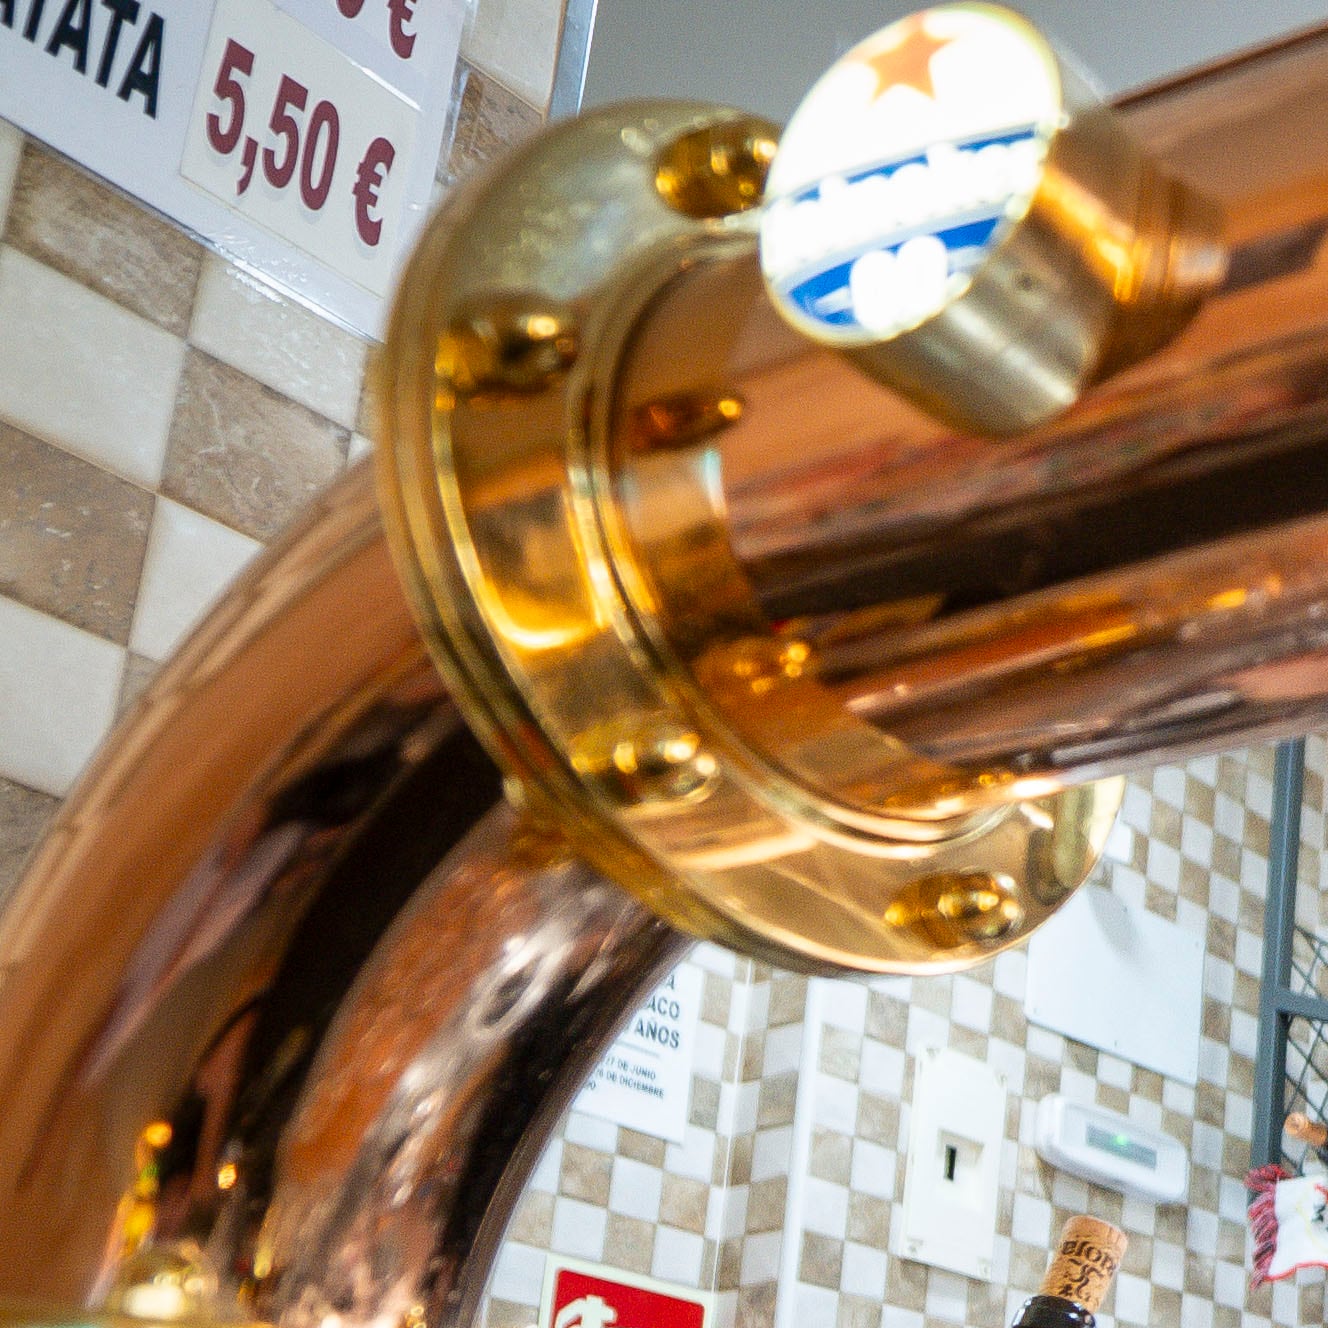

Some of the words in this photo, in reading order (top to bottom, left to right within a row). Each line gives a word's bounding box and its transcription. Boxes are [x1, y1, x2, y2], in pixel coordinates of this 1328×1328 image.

[206, 37, 340, 210] 5,50
[352, 137, 396, 248] €
[647, 995, 680, 1020] ACO
[634, 1015, 681, 1049] AÑOS
